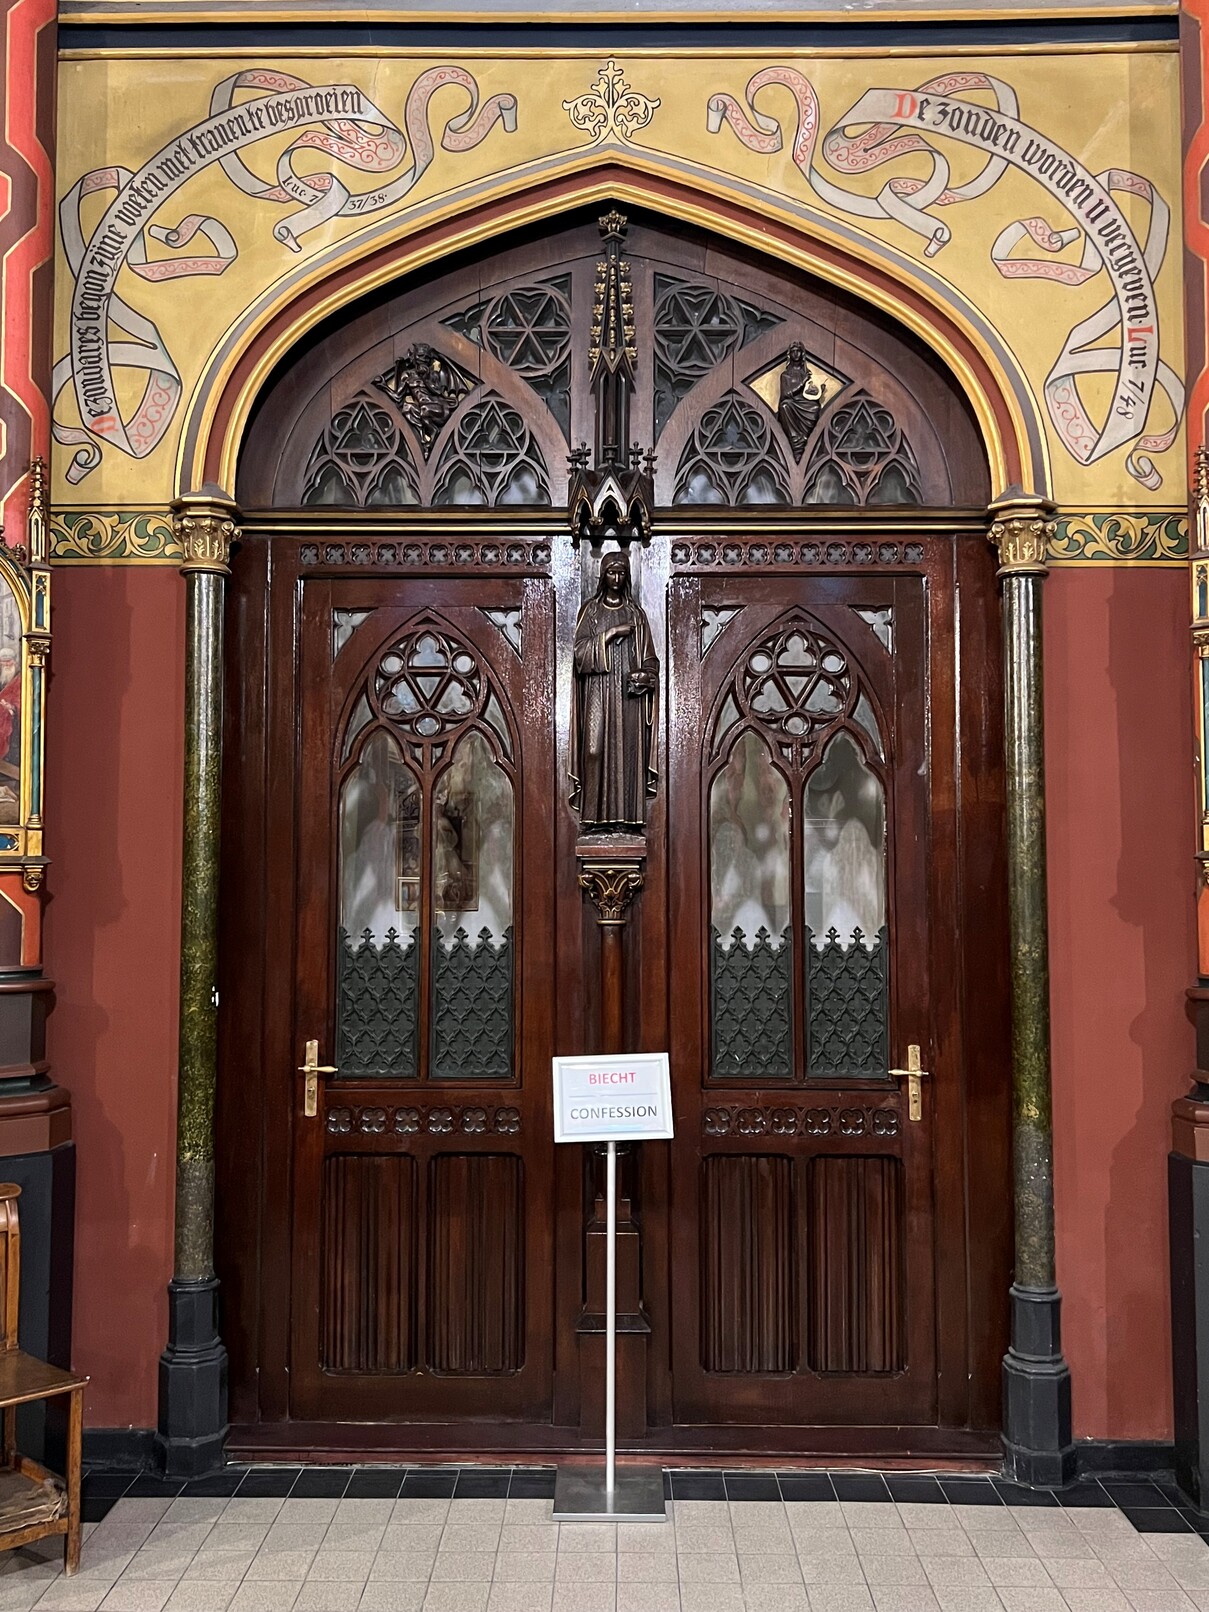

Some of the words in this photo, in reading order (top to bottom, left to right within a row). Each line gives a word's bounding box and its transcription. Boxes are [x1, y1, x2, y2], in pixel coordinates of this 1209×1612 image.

[74, 269, 111, 320] begon
[115, 172, 168, 226] voeten
[156, 140, 196, 181] met
[186, 114, 251, 158] tranen
[245, 104, 265, 130] te
[263, 88, 363, 129] besproeien
[309, 194, 320, 203] 7
[889, 93, 931, 121] De
[932, 102, 1021, 154] zonden
[1021, 139, 1094, 210] worden
[1085, 198, 1110, 224] u
[1116, 379, 1145, 419] 7/48
[589, 1072, 636, 1085] BIECHT
[570, 1105, 658, 1120] CONFESSION
